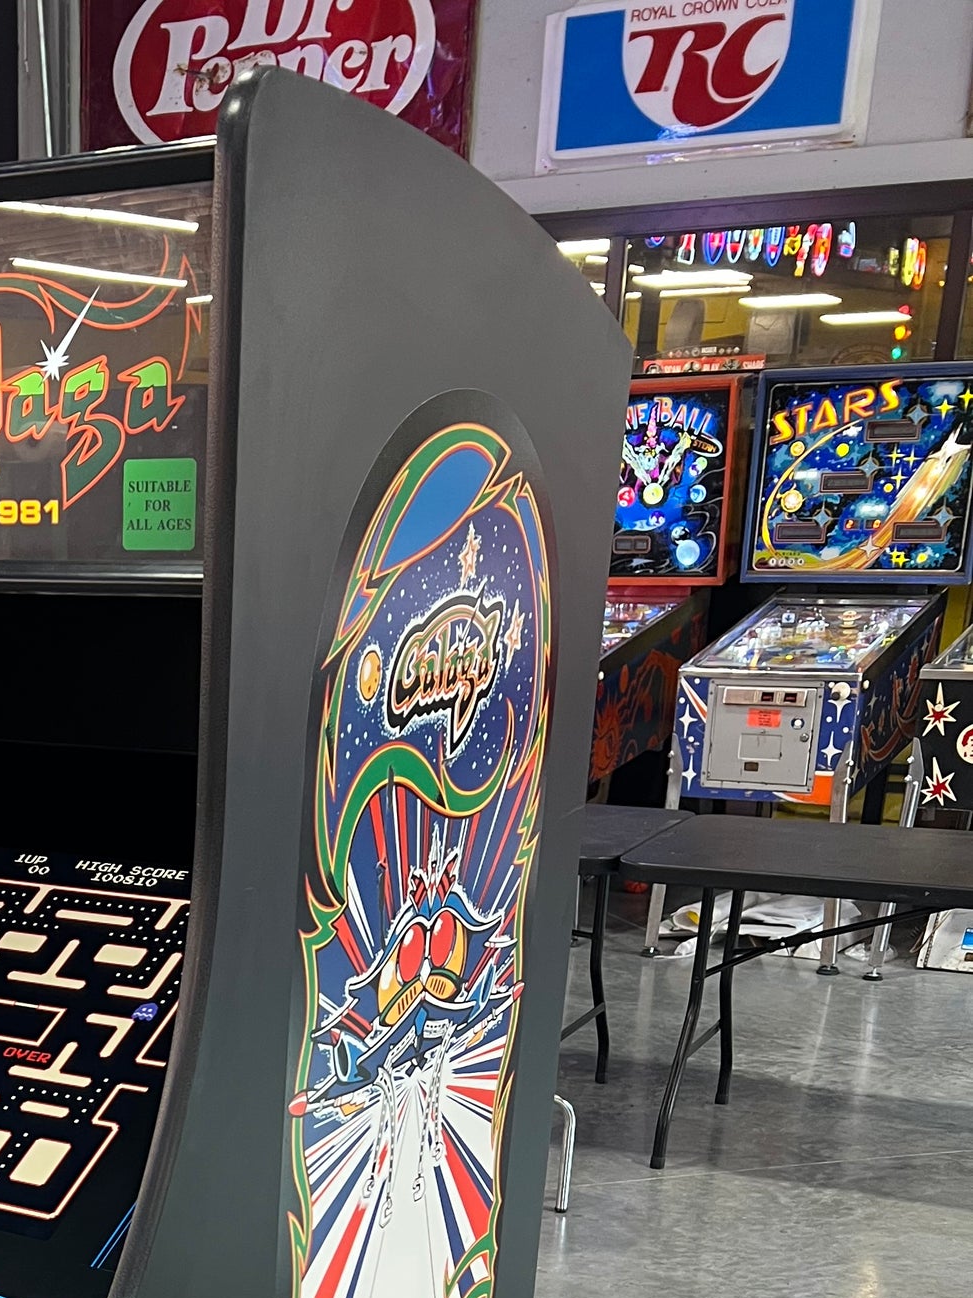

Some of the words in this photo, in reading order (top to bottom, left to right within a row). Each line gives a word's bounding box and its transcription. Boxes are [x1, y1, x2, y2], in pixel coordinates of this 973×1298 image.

[630, 5, 676, 22] ROYAL
[682, 0, 738, 16] CROWN
[628, 13, 786, 127] RC
[653, 397, 714, 438] BALL
[769, 379, 903, 445] STARS
[127, 479, 192, 493] SUITABLE
[144, 499, 172, 513] FOR
[127, 519, 151, 532] ALL
[156, 518, 192, 532] AGES
[393, 612, 496, 735] Galaga
[14, 853, 48, 865] 1UP
[74, 860, 123, 873] HIGH
[129, 865, 189, 880] SCORE
[28, 864, 50, 875] 00
[3, 1047, 52, 1064] OVER
